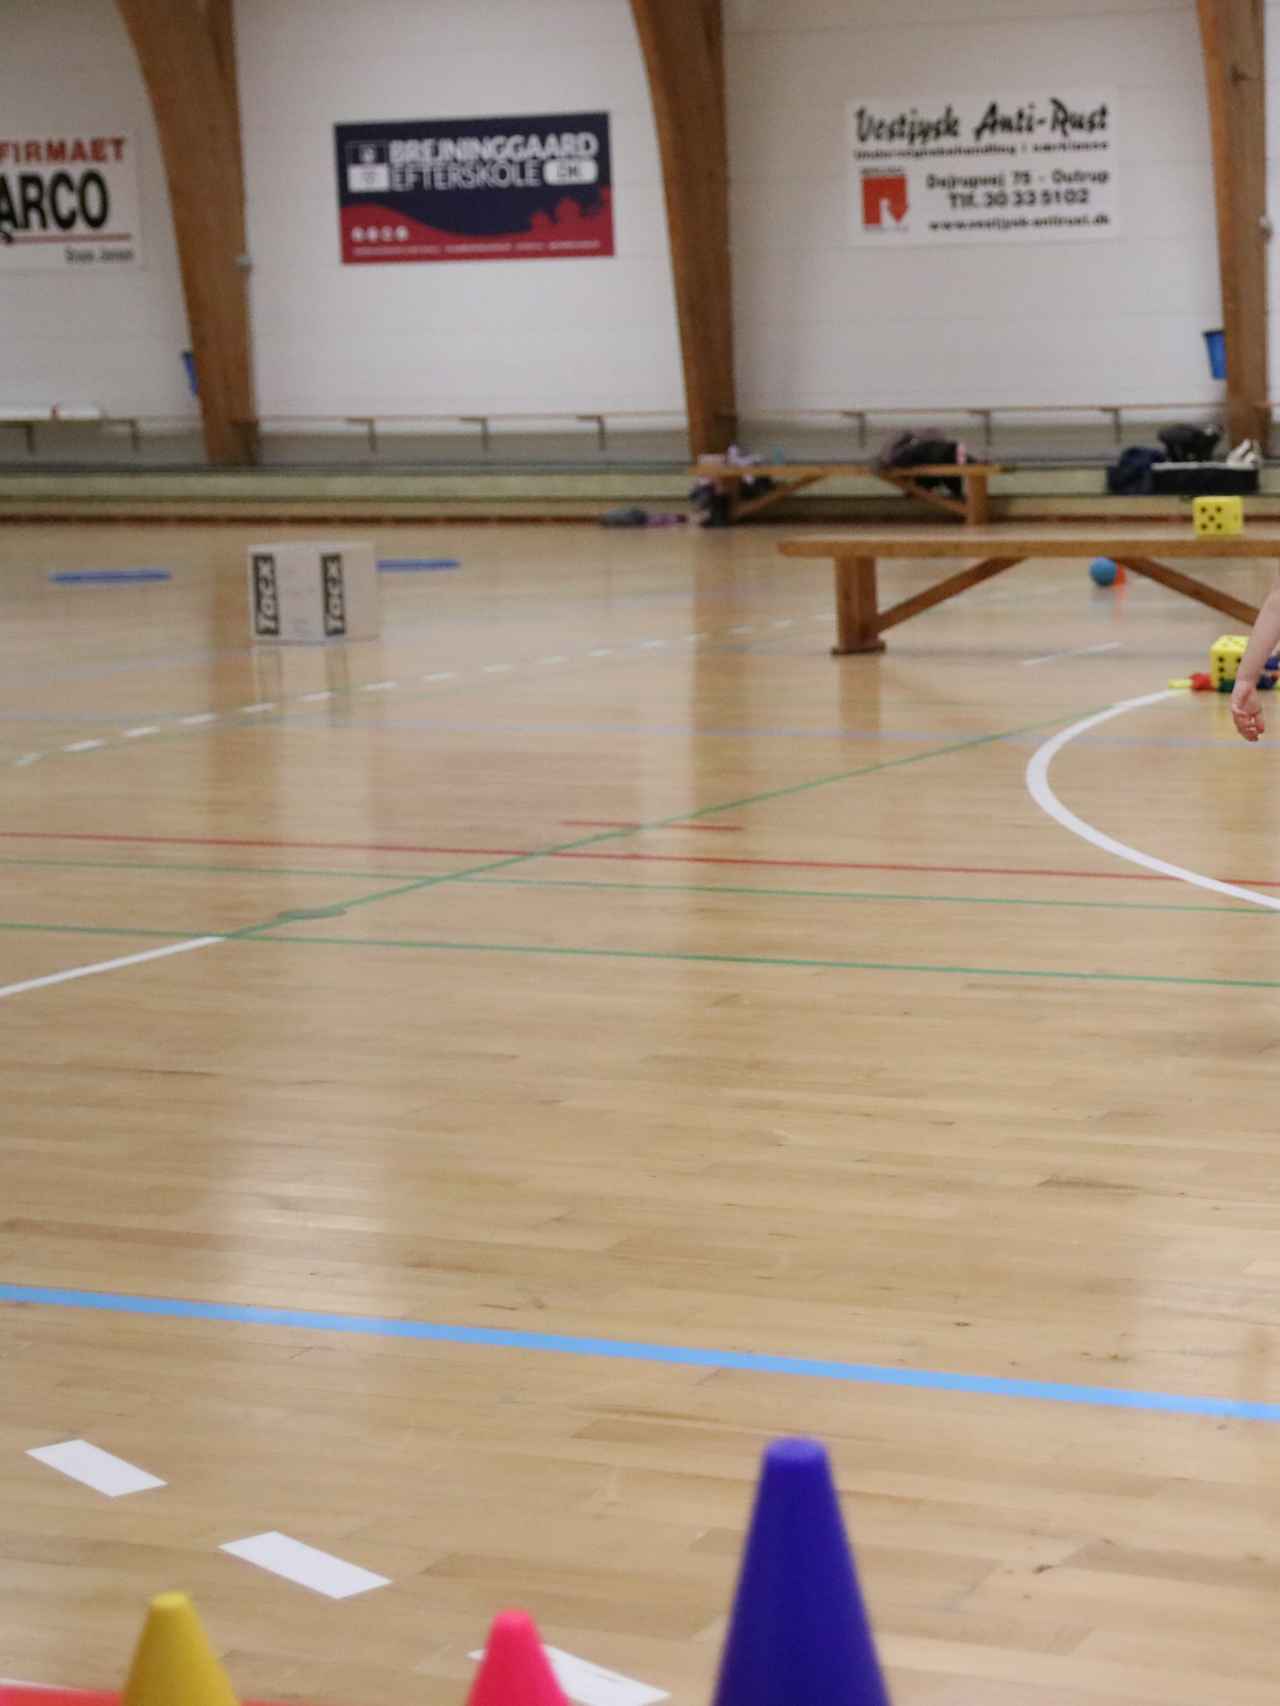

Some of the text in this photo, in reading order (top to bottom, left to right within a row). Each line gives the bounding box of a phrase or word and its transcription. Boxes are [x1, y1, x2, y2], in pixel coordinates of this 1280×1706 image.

[856, 97, 1108, 144] Vestjysk Anti-Rust
[390, 159, 542, 192] EFTERSKOLE
[984, 190, 1008, 207] 30
